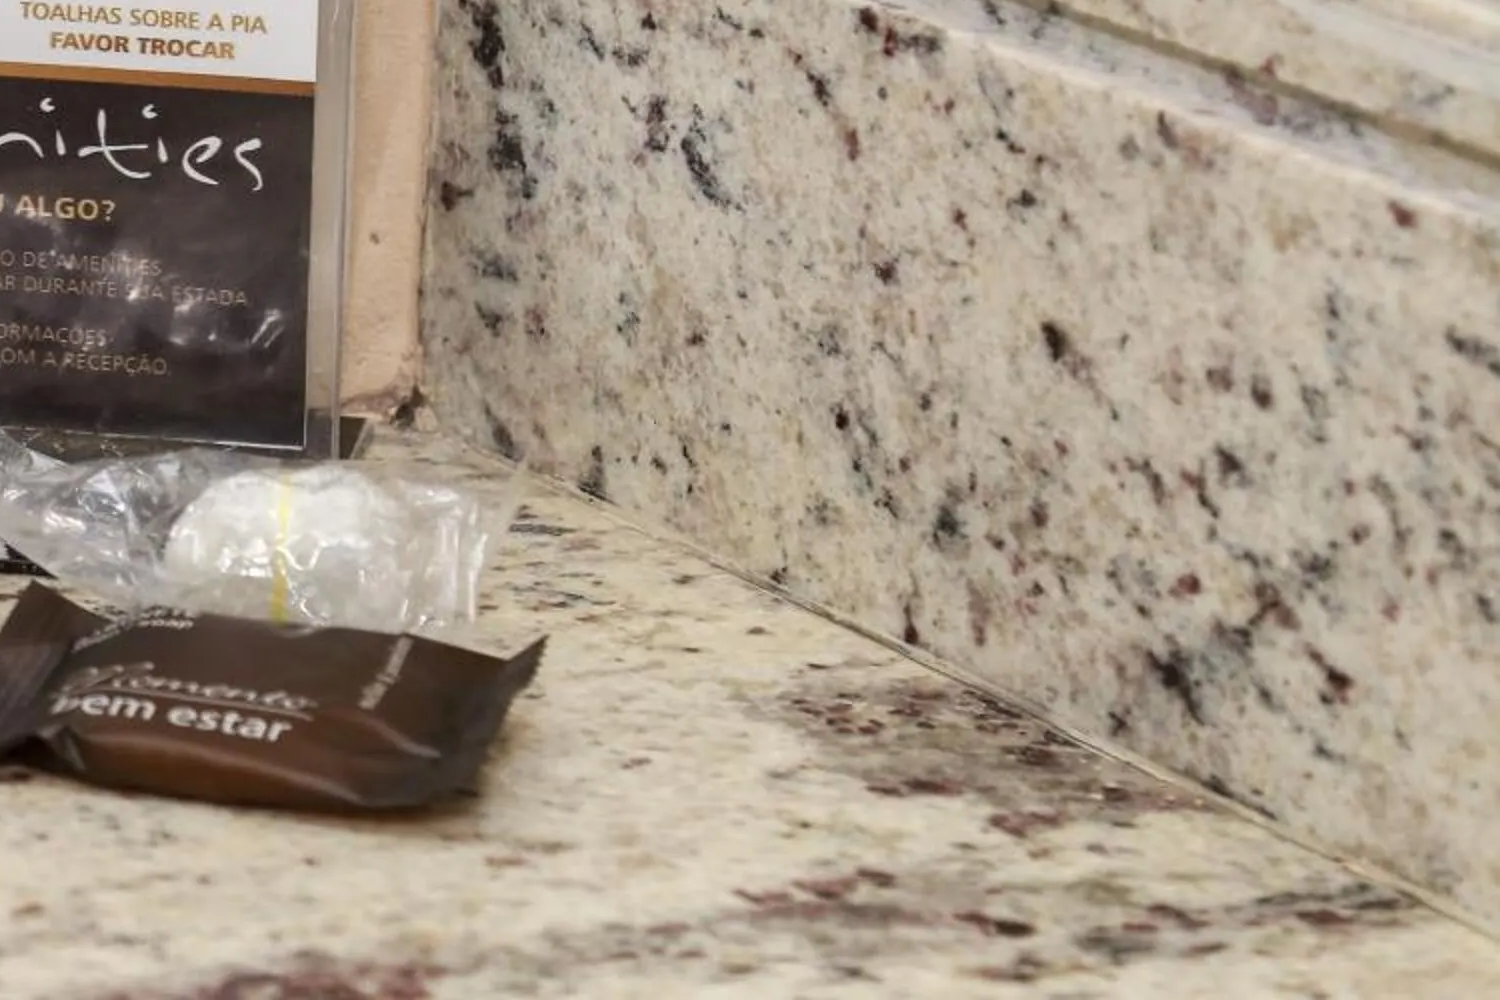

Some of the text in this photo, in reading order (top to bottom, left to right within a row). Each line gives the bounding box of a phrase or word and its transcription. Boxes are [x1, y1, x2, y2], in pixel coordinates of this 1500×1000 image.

[20, 1, 269, 35] TOALHAS SOBRE A PIA
[50, 31, 236, 60] FAVOR TROCAR
[14, 196, 117, 223] ALGO?
[23, 250, 48, 268] DE
[56, 252, 162, 278] AMENITES
[23, 277, 118, 299] DURANTE
[171, 285, 247, 306] ESTADA
[43, 351, 60, 368] A
[166, 702, 294, 743] estar
